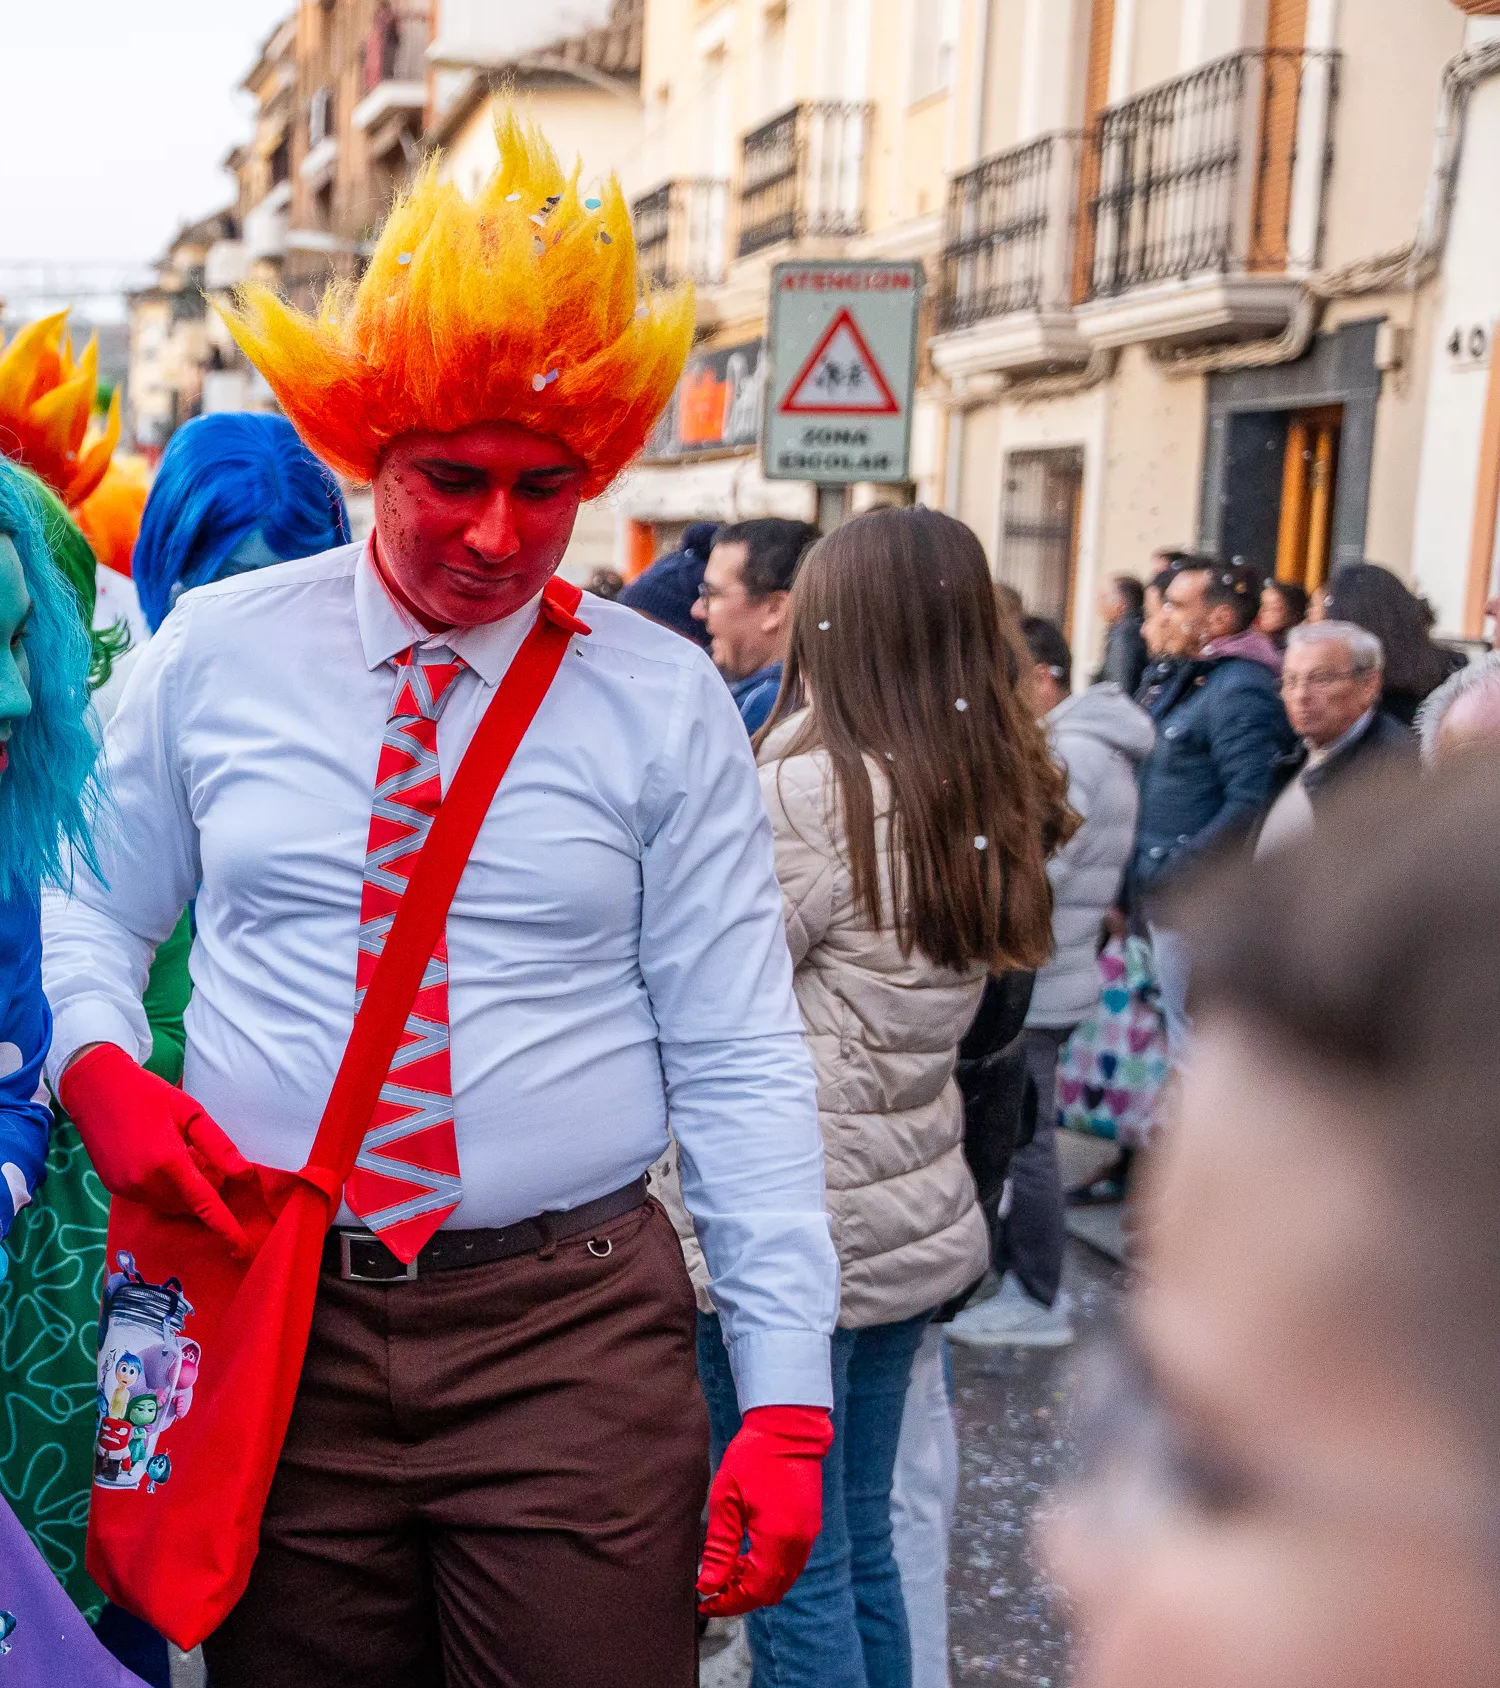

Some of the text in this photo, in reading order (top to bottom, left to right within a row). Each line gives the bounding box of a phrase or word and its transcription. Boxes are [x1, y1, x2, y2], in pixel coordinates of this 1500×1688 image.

[1445, 325, 1487, 358] 40
[802, 428, 867, 447] ZONA
[778, 453, 890, 471] ESCOLAR
